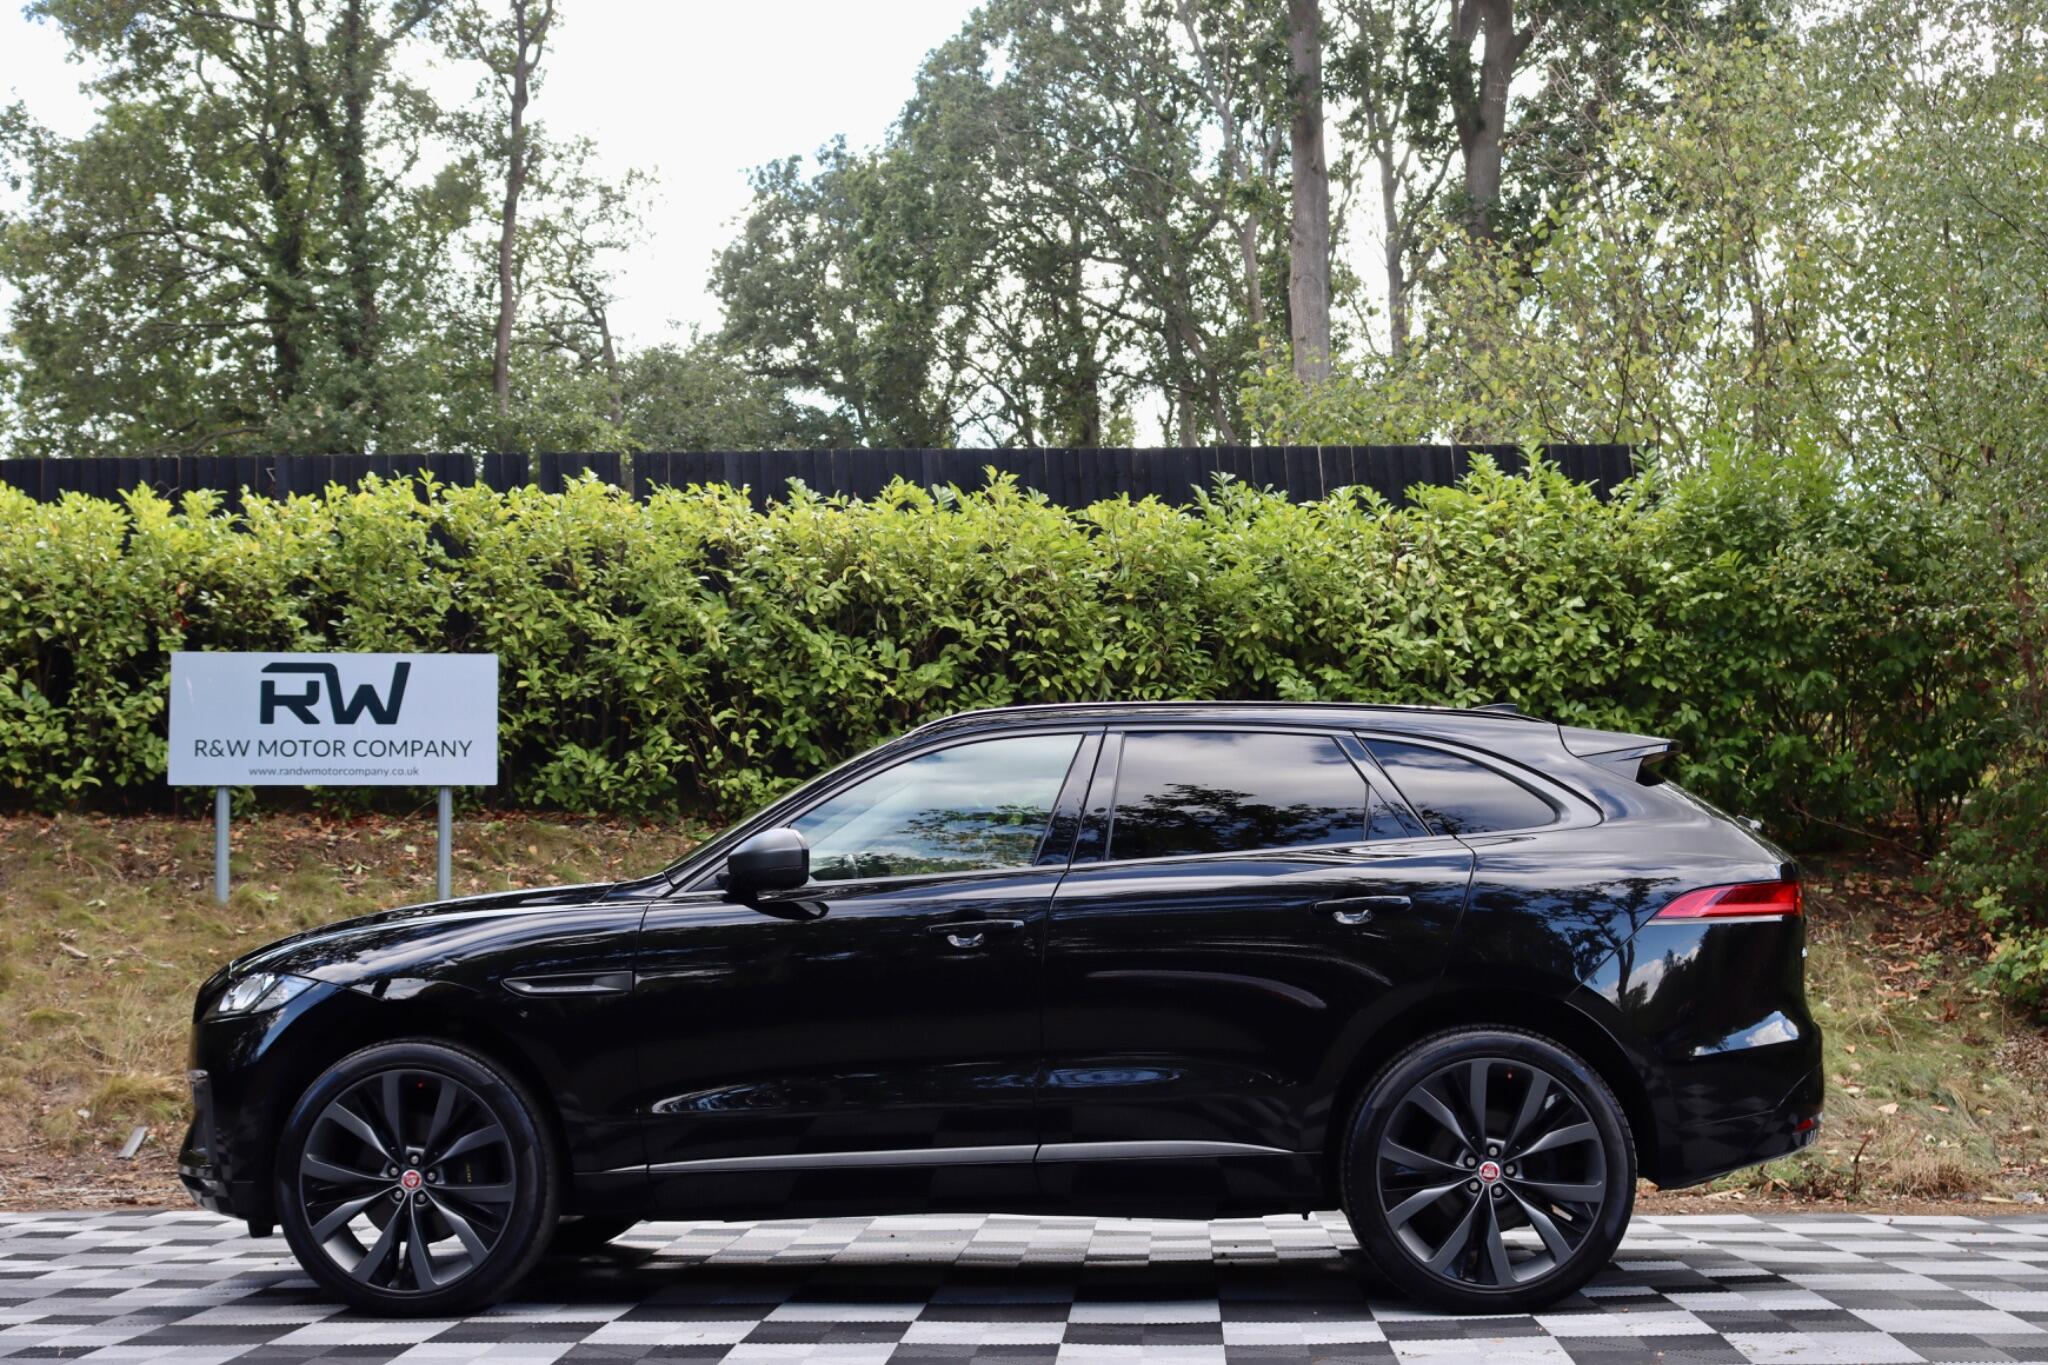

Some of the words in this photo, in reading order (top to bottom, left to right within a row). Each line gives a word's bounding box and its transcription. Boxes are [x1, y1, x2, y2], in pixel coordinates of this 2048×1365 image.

[260, 662, 411, 725] RW
[194, 739, 250, 758] R&W
[258, 739, 346, 758] MOTOR
[353, 739, 473, 758] COMPANY
[248, 766, 420, 777] www.randwmotorcompany.co.uk
